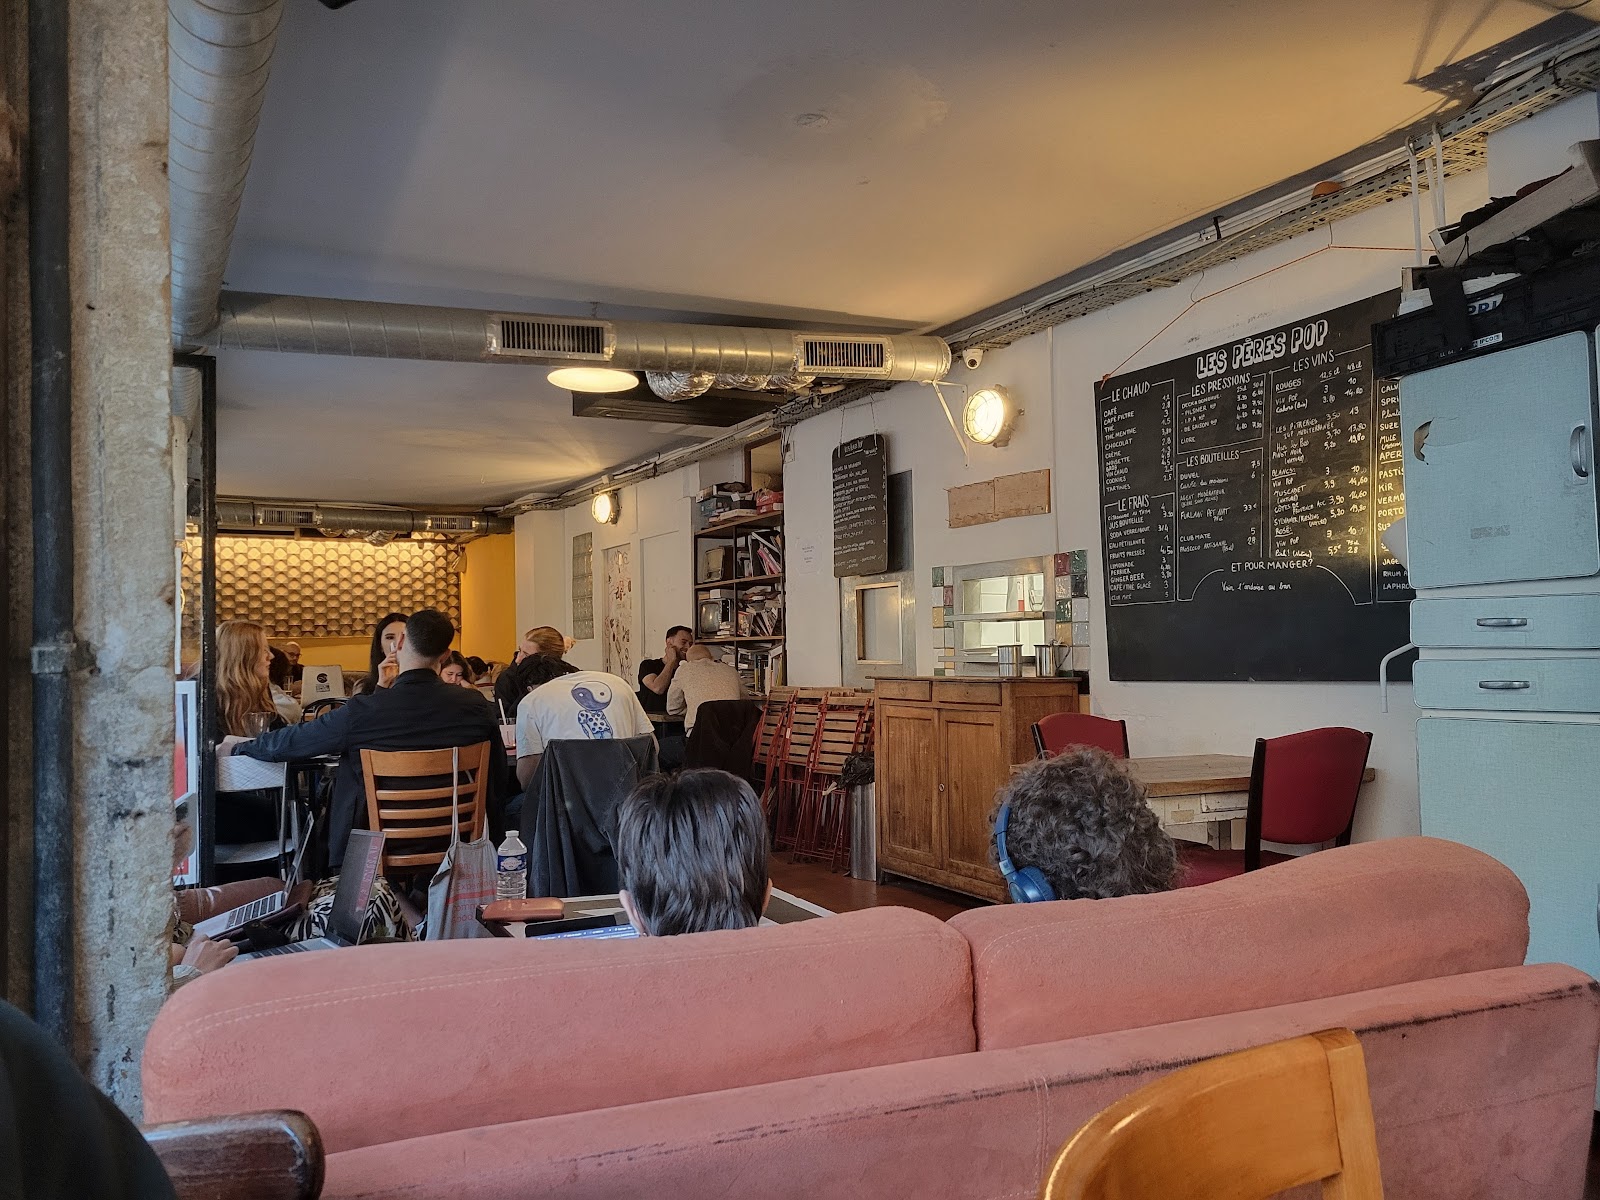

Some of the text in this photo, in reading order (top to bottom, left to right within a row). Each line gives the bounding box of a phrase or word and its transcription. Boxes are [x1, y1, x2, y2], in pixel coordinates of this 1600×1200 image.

[1196, 349, 1227, 379] LES
[1290, 319, 1328, 354] POP
[1293, 349, 1334, 372] LES VINS
[1191, 372, 1250, 397] LES PRESSIONS
[1275, 378, 1302, 391] ROUGES
[1323, 384, 1329, 393] 3
[1111, 381, 1150, 402] LE CHAUD
[1103, 406, 1118, 418] CAFÉ
[1117, 410, 1135, 422] FILTRE
[1163, 410, 1169, 418] 3
[1379, 422, 1399, 432] SUZE
[1104, 438, 1133, 450] CHOCOLAT
[1380, 434, 1397, 444] MULE
[1186, 455, 1198, 467] LES
[1200, 450, 1240, 465] BOUTEILLES
[1325, 466, 1331, 475] 3
[1179, 472, 1200, 481] DUVEL
[1107, 484, 1131, 492] TARTINES
[1118, 494, 1149, 512] LE FRAIS
[1377, 507, 1404, 517] PORTO
[1109, 516, 1145, 530] JUS BOUTEILLE
[1109, 530, 1123, 540] SODA
[1250, 527, 1256, 535] 5
[1326, 529, 1332, 538] 3
[1179, 532, 1211, 543] CLUB MATE
[1109, 551, 1125, 560] FRUITS
[1110, 560, 1135, 570] LIMONADE
[1231, 558, 1314, 573] ET POUR MANGER?
[1110, 572, 1145, 584] GINGER BEER
[1163, 580, 1169, 589] 3
